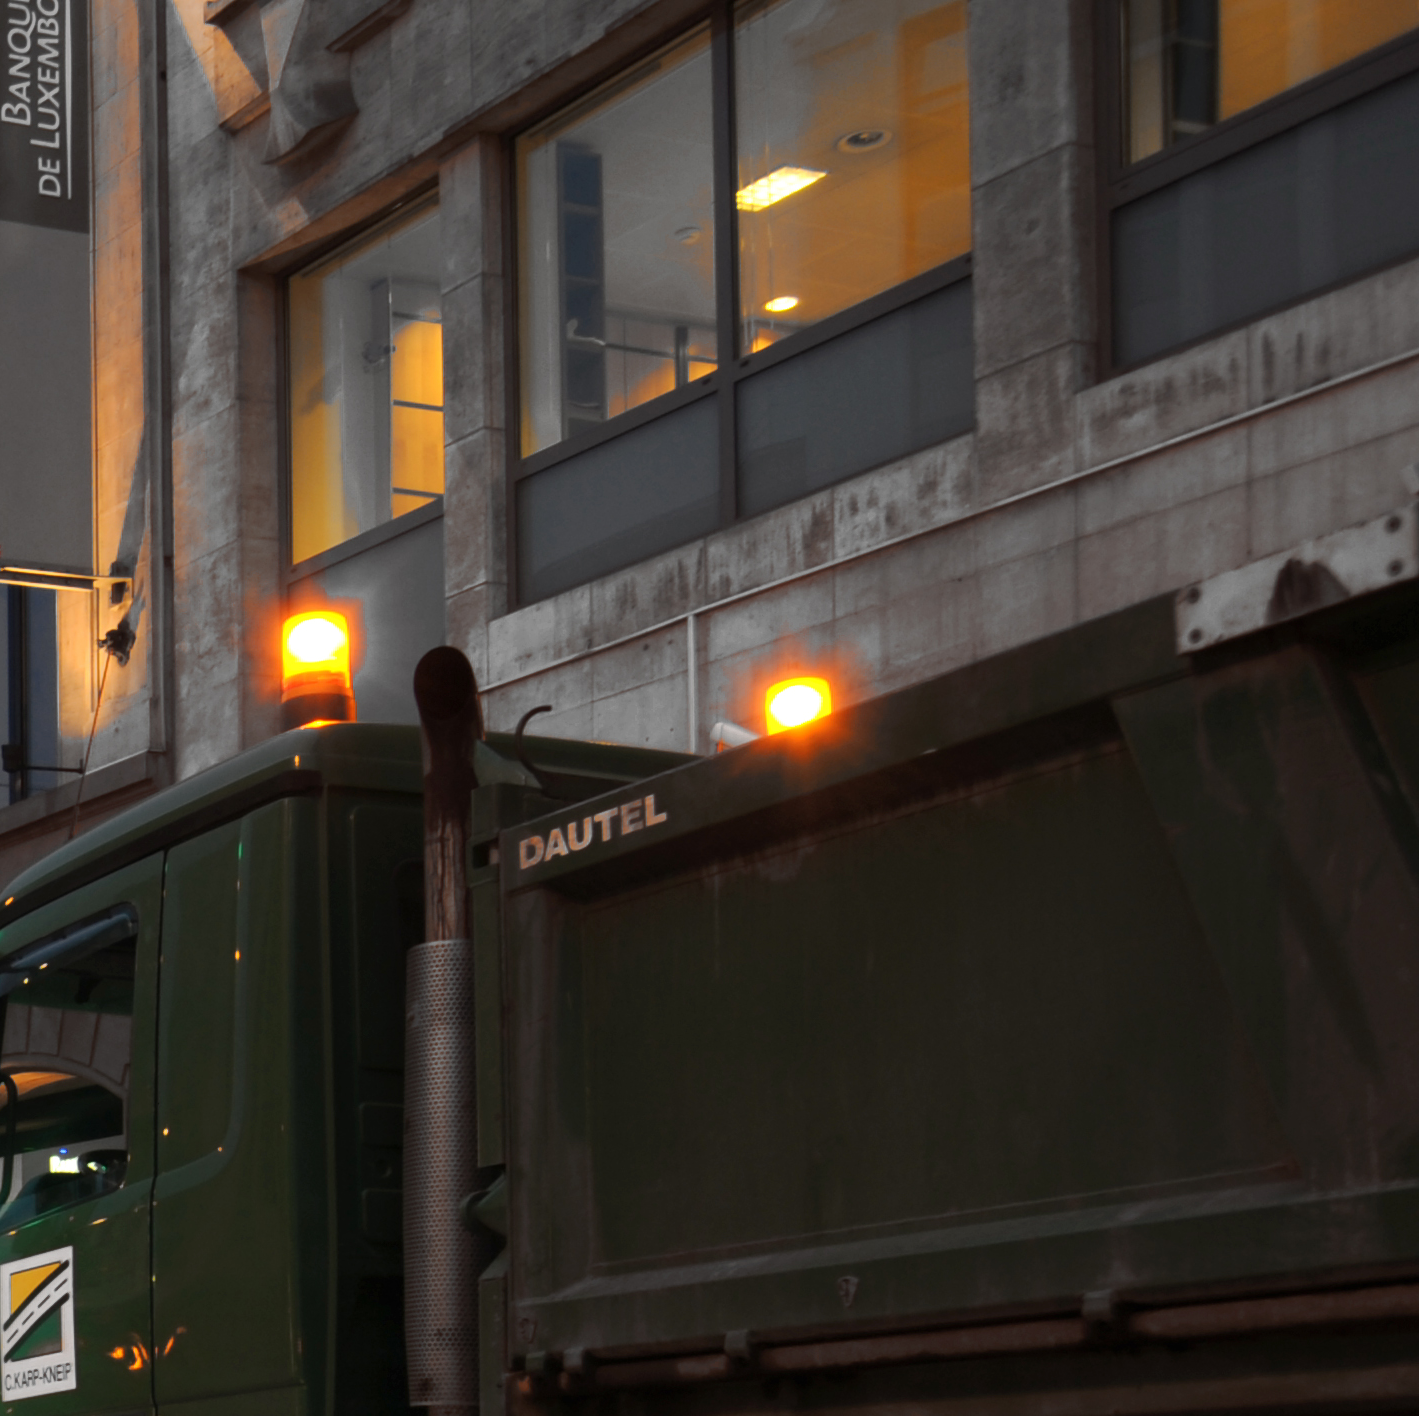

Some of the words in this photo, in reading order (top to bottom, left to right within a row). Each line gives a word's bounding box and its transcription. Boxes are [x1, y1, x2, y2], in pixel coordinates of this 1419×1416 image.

[1, 0, 36, 126] BANQU
[38, 157, 61, 198] DE
[519, 794, 667, 870] DAUTEL
[4, 1362, 73, 1392] C.KARP-KNEIP
